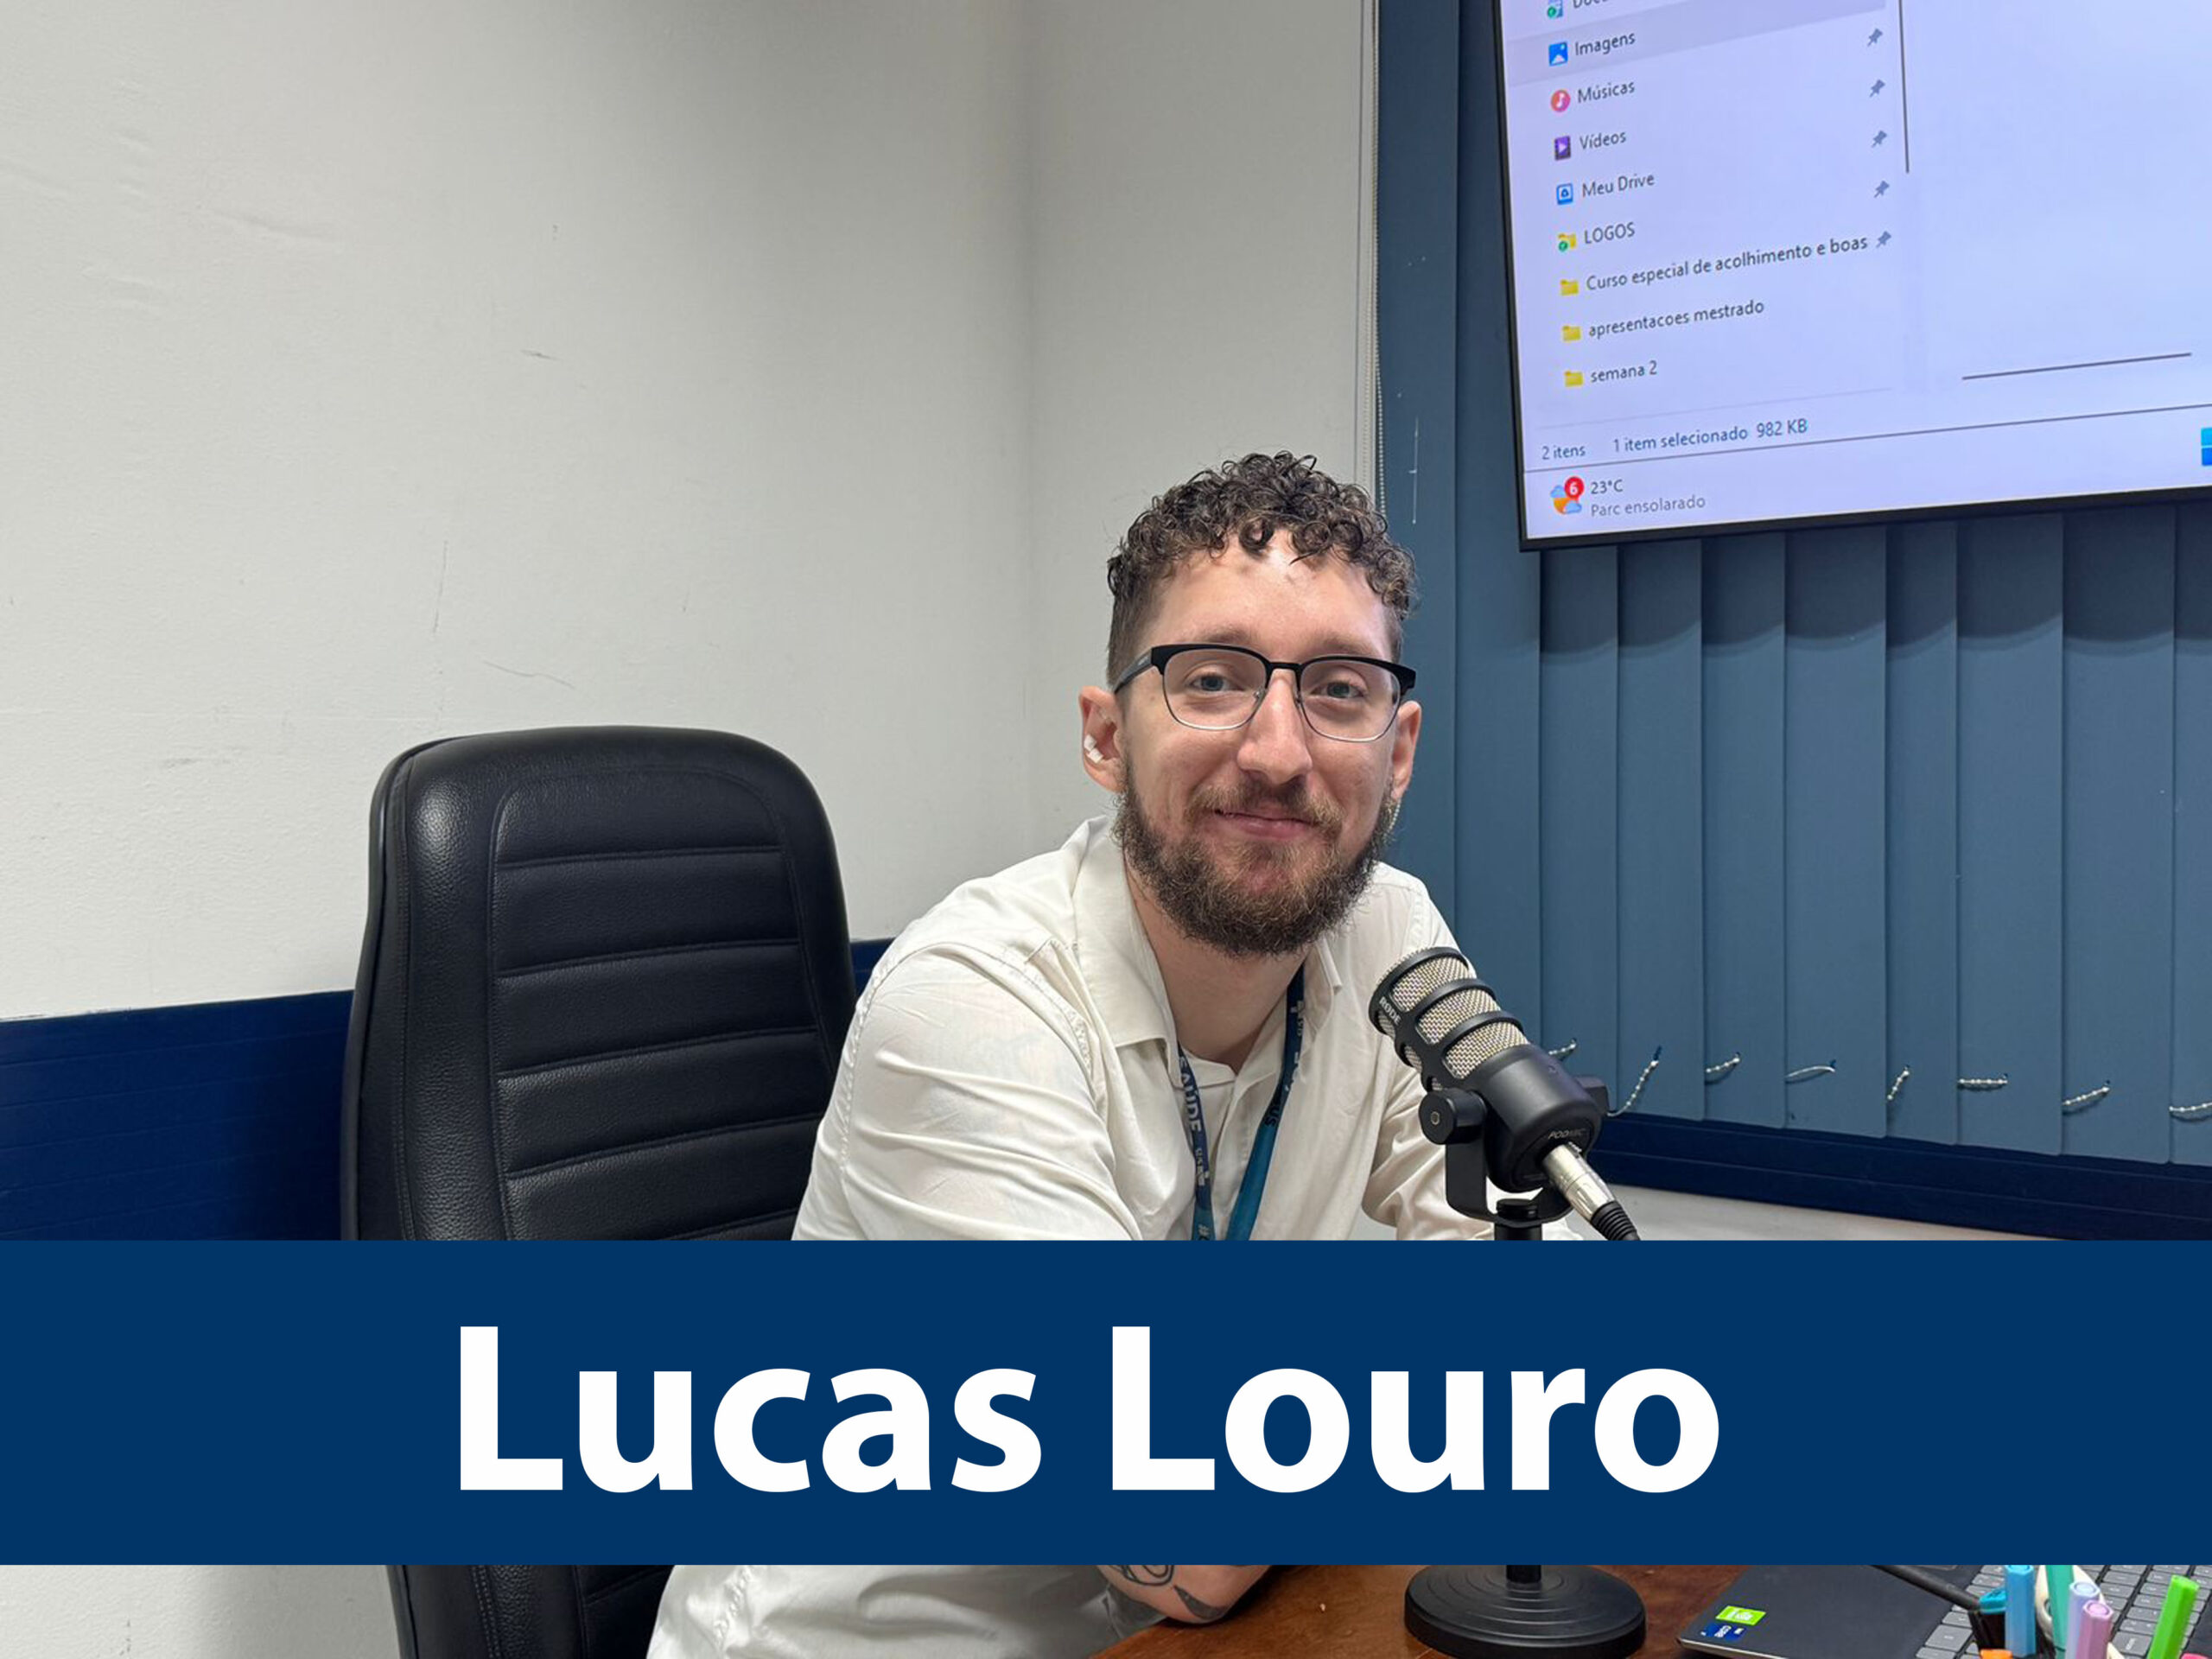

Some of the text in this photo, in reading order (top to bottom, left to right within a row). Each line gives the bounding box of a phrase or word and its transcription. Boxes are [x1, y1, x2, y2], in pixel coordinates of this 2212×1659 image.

[1574, 33, 1636, 55] Imagens
[1578, 79, 1636, 103] Músicas
[1580, 130, 1627, 150] Vídeos
[1582, 172, 1655, 198] Meu Drive
[1584, 222, 1636, 245] LOGOS
[1586, 236, 1868, 291] Curso especial de acolhimento e boas
[1589, 300, 1765, 340] apresentacoes mestrado
[1590, 360, 1658, 383] semana 2
[1541, 418, 1808, 461] 2 itens 1 item selecionado 982 KB
[1590, 479, 1624, 495] 23°C
[1591, 495, 1706, 518] Parc ensolarado
